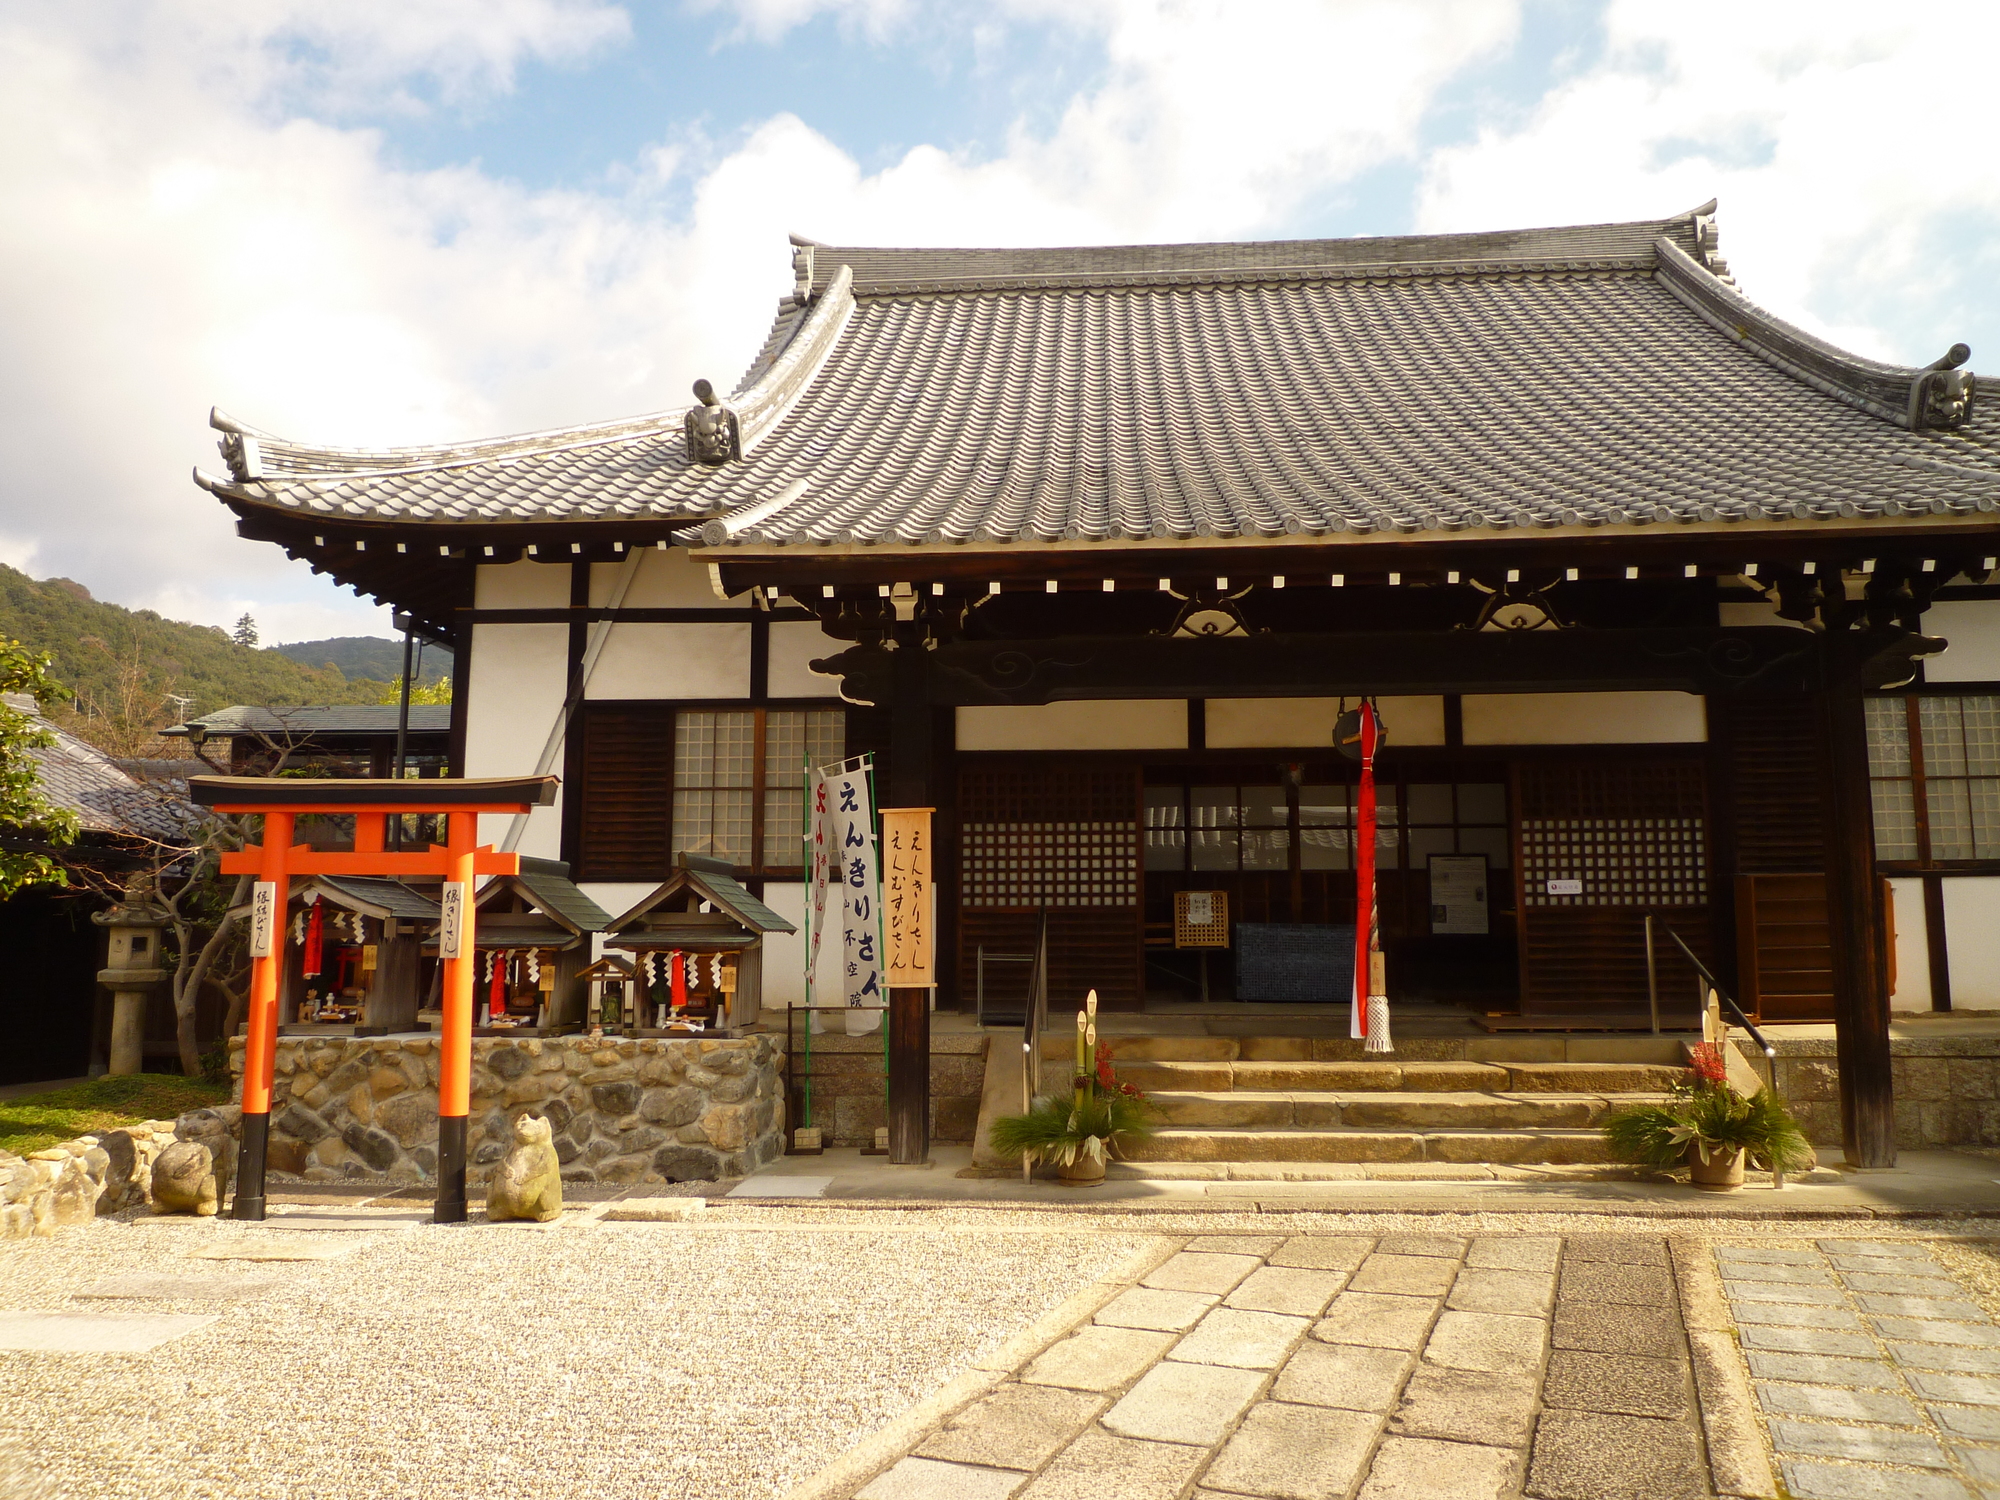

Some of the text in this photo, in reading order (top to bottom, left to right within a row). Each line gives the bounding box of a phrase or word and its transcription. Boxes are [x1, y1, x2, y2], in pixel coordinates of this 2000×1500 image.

[255, 890, 270, 950] 縁結びさん
[444, 888, 460, 953] 縁きりさん
[839, 781, 879, 997] えんきりさん
[890, 830, 906, 970] えんむすびさん
[910, 830, 925, 970] えんきりさん
